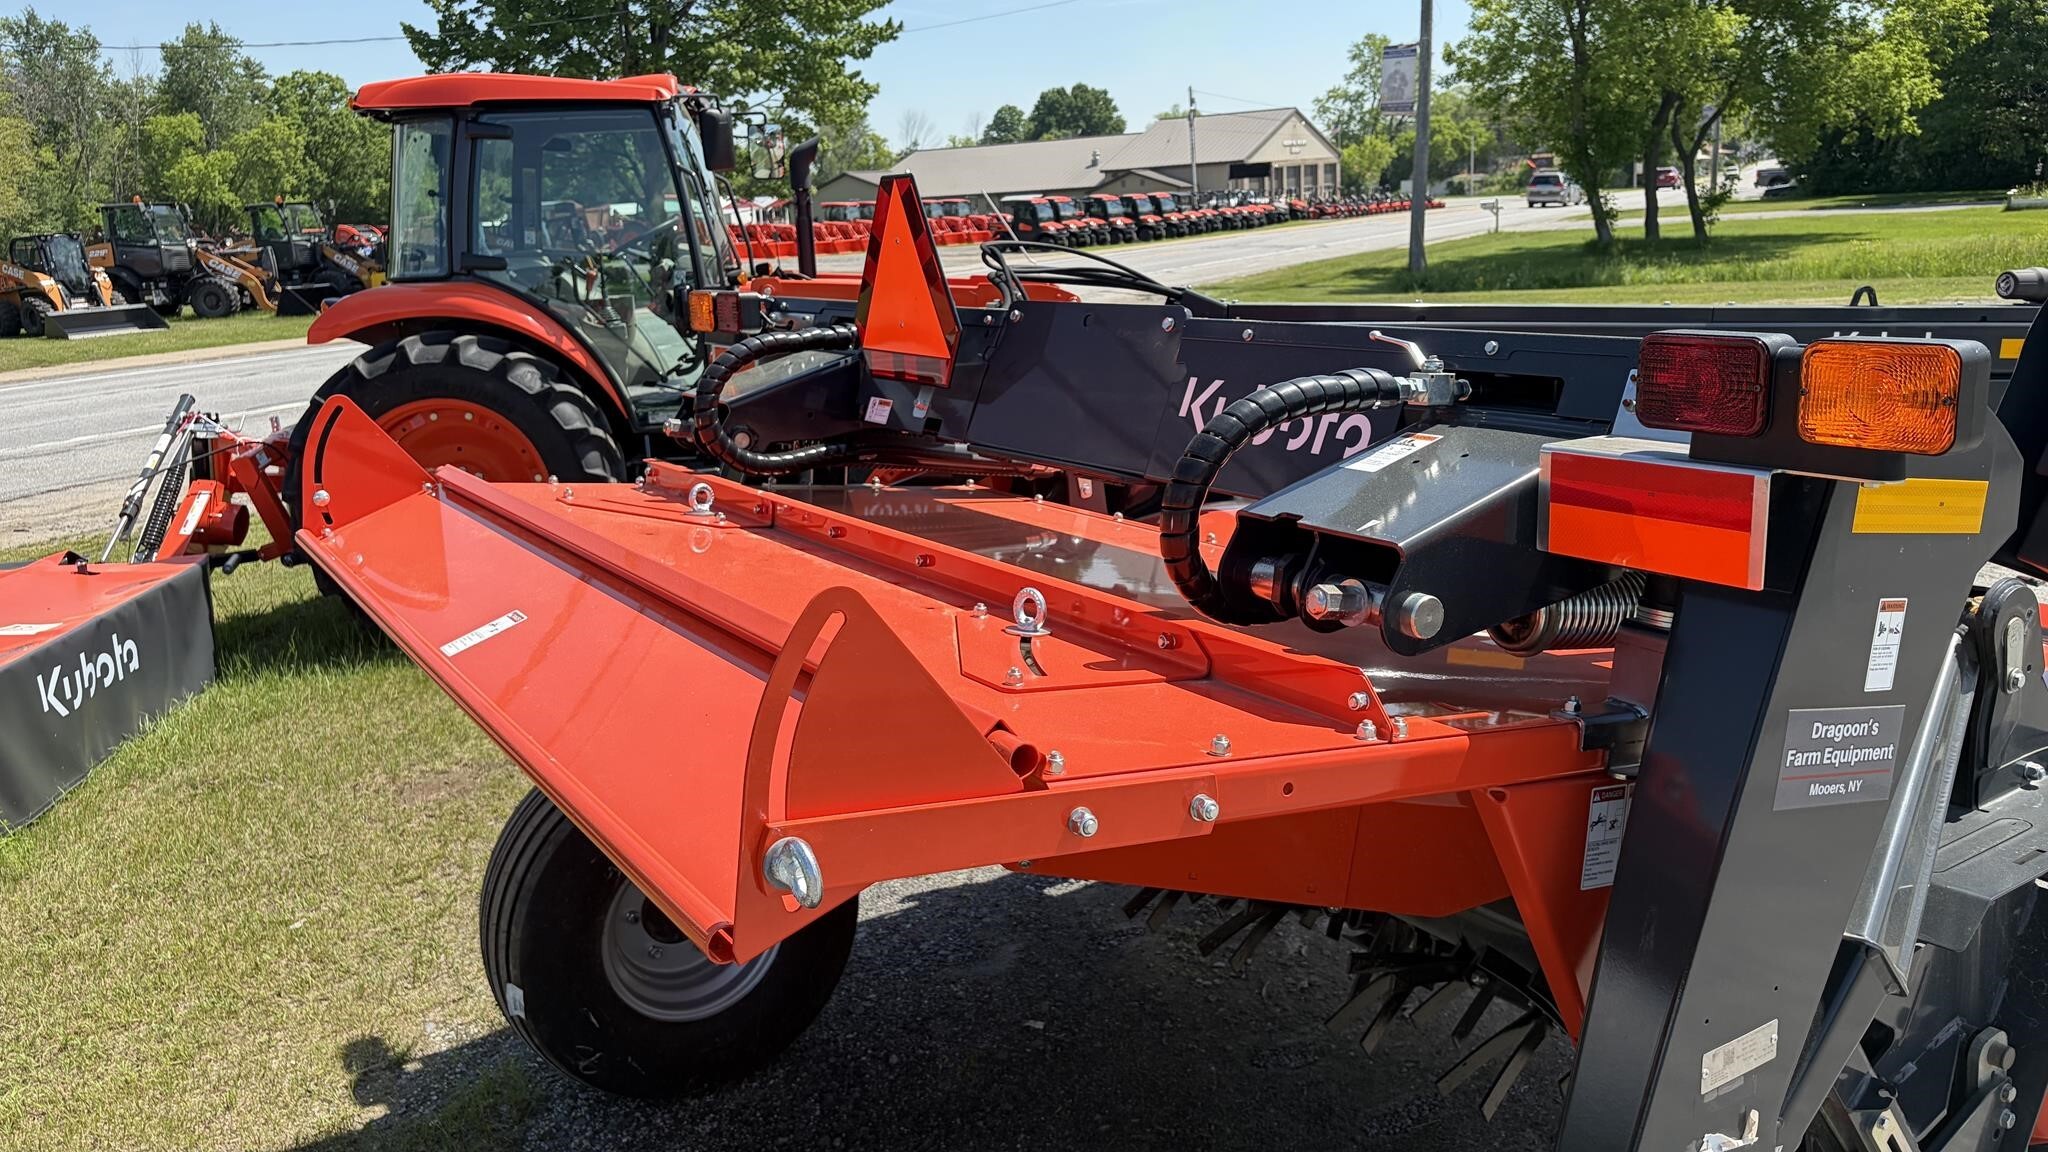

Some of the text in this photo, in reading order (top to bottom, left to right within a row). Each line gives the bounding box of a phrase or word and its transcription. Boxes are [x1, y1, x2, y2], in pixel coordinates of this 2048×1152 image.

[2, 264, 25, 279] CASE
[208, 259, 242, 279] CASE
[333, 253, 359, 273] CASE
[1178, 377, 1372, 459] Kota
[36, 633, 139, 718] Kubota
[1811, 718, 1880, 742] Dragoon's
[1785, 743, 1895, 767] Farm Equipment
[1809, 779, 1863, 796] Mooers, NY
